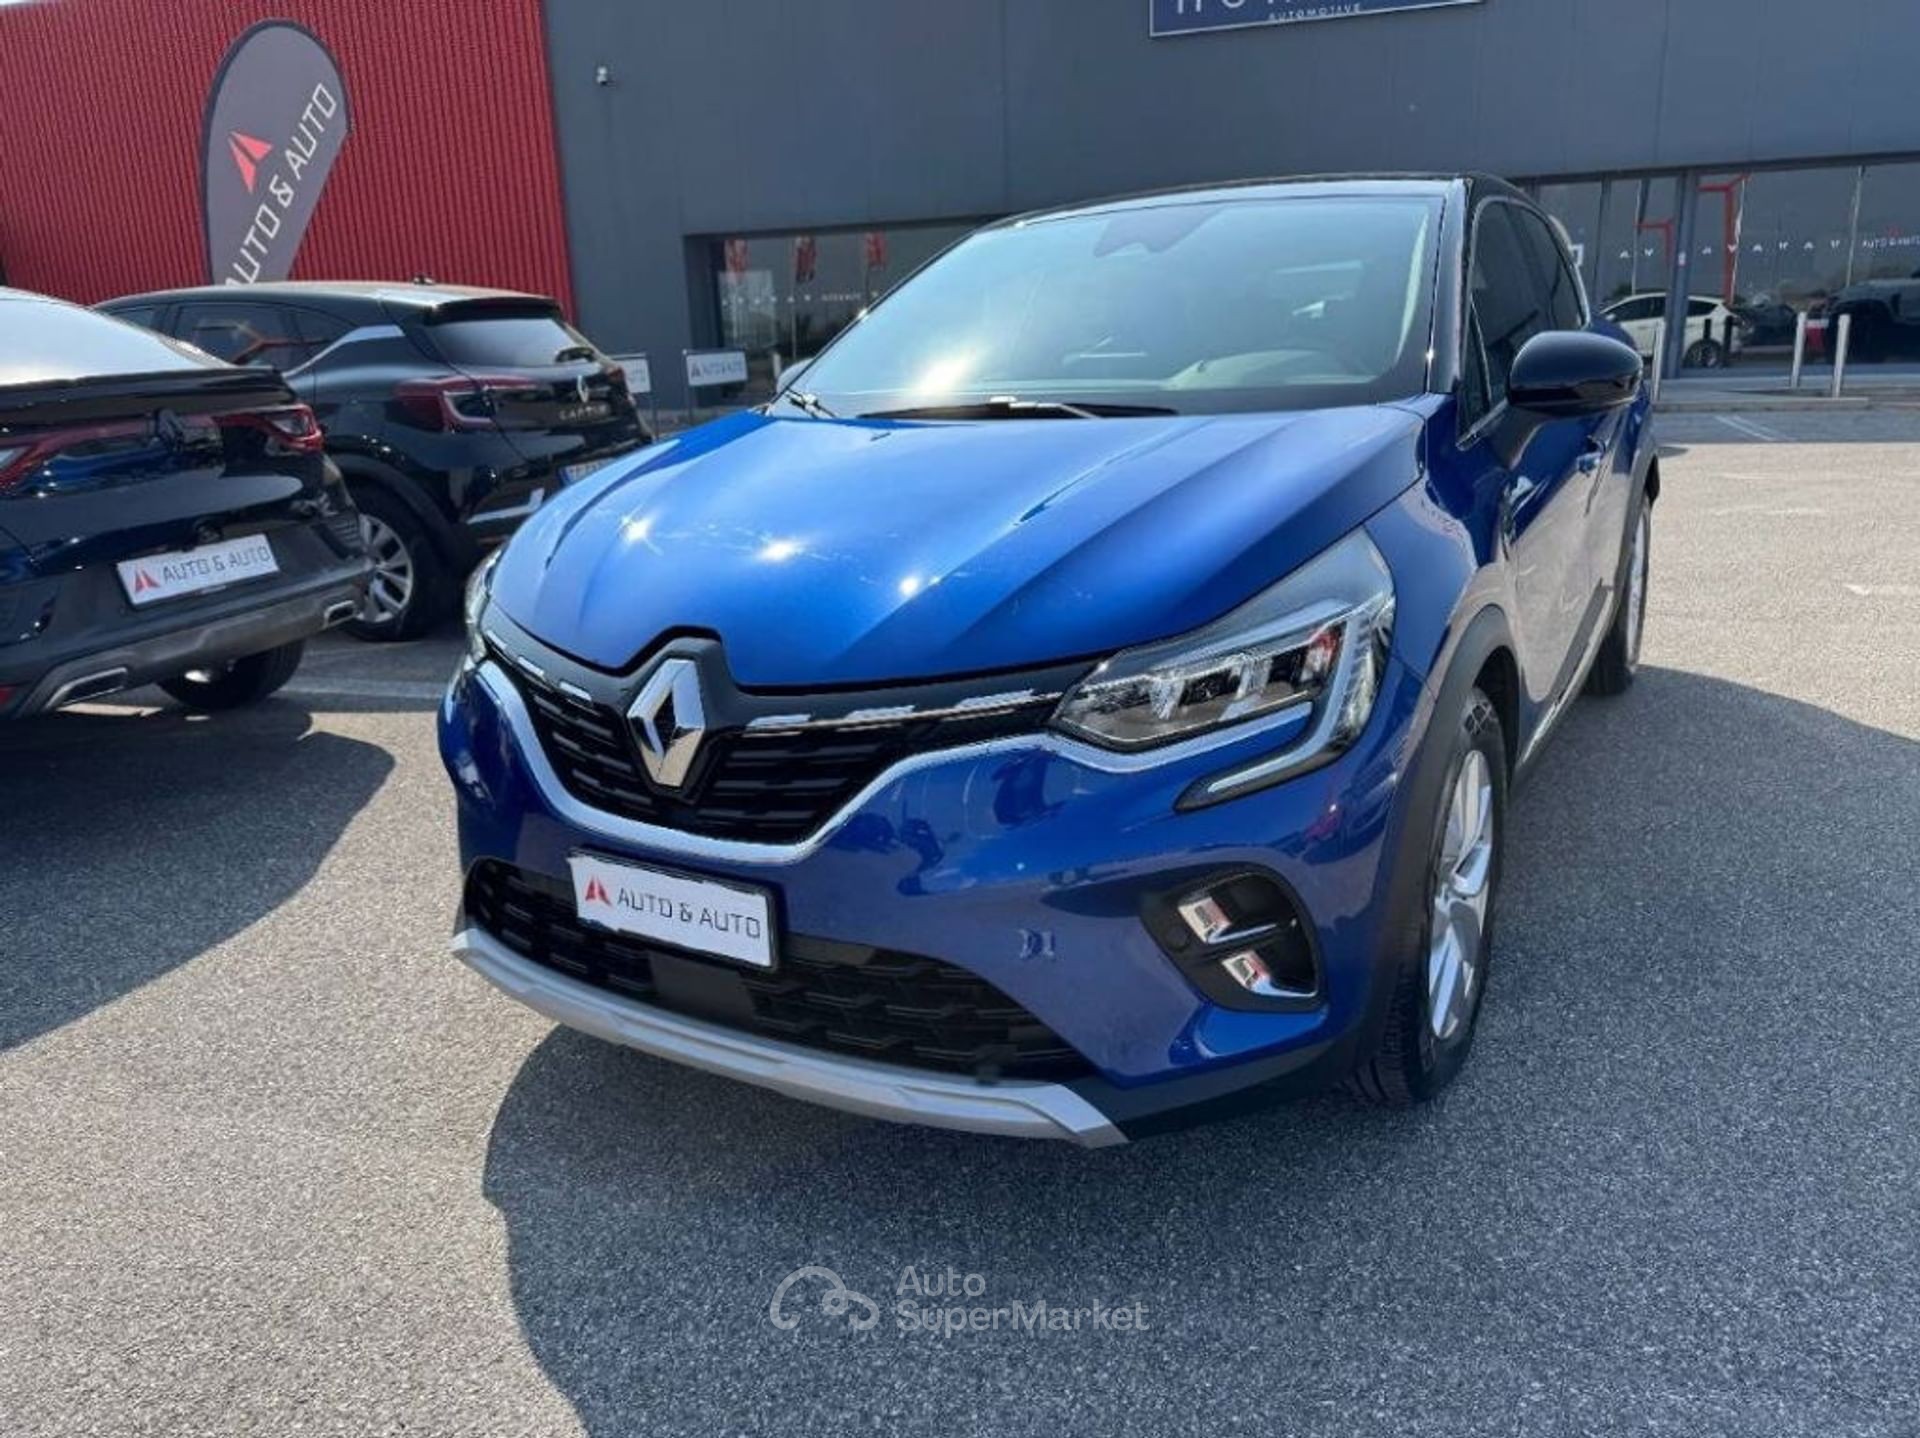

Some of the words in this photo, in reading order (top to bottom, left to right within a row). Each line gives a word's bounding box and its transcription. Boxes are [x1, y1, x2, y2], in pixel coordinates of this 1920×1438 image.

[1268, 4, 1362, 22] AUTOMOTIVE
[269, 174, 295, 208] &
[285, 83, 337, 180] AUTO
[163, 558, 211, 583] AUTO
[212, 555, 225, 572] &
[229, 546, 271, 568] AUTO
[617, 887, 673, 919] AUTO
[680, 902, 693, 923] &
[700, 907, 761, 939] AUTO
